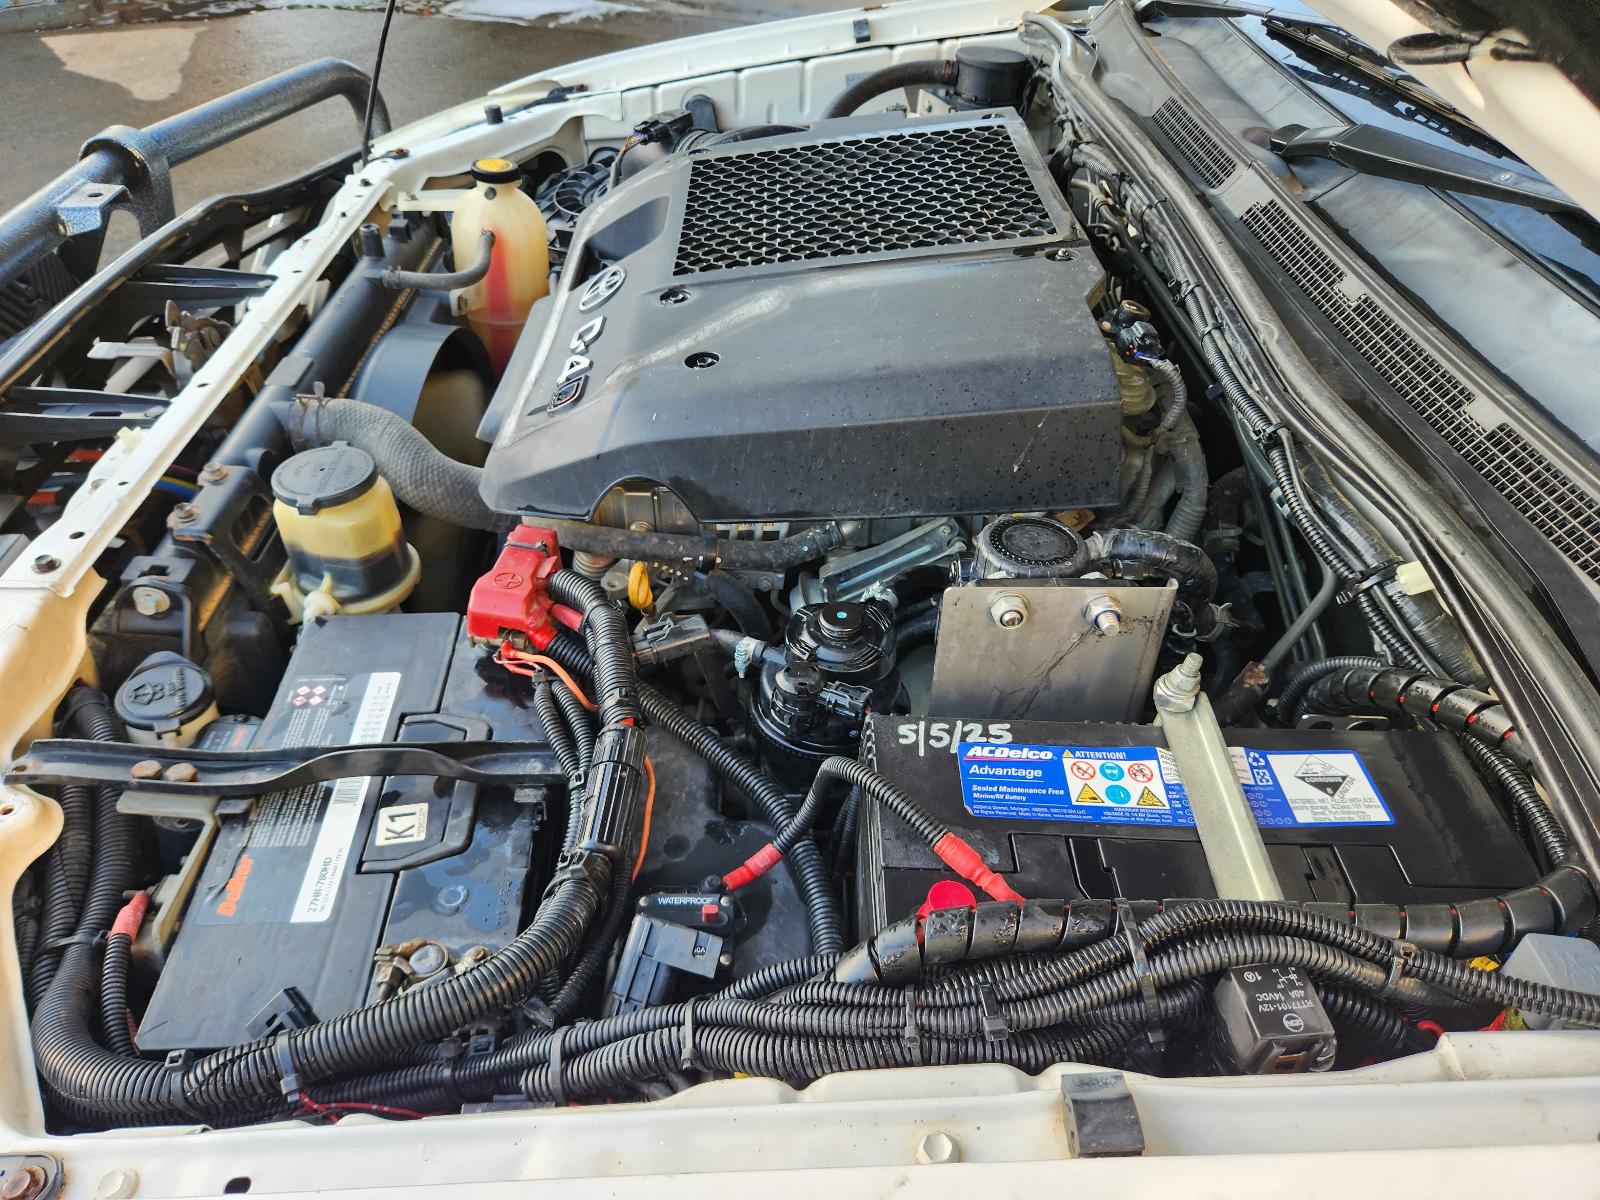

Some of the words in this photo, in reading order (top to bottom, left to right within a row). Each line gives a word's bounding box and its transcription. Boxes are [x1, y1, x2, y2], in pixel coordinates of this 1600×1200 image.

[898, 720, 1013, 757] 5/5/25
[966, 746, 1054, 760] ACDelco
[1075, 750, 1127, 760] ATTENTION!
[969, 764, 1043, 778] Advantage
[972, 784, 997, 793] Sealed
[999, 786, 1046, 795] Maintenance
[973, 792, 1003, 800] Marine/RV
[385, 811, 417, 840] K1
[657, 897, 713, 905] WATERPROOF
[1256, 991, 1285, 1001] 14VDC
[1288, 989, 1305, 998] 40A
[1258, 999, 1314, 1012] RTT7101-12V
